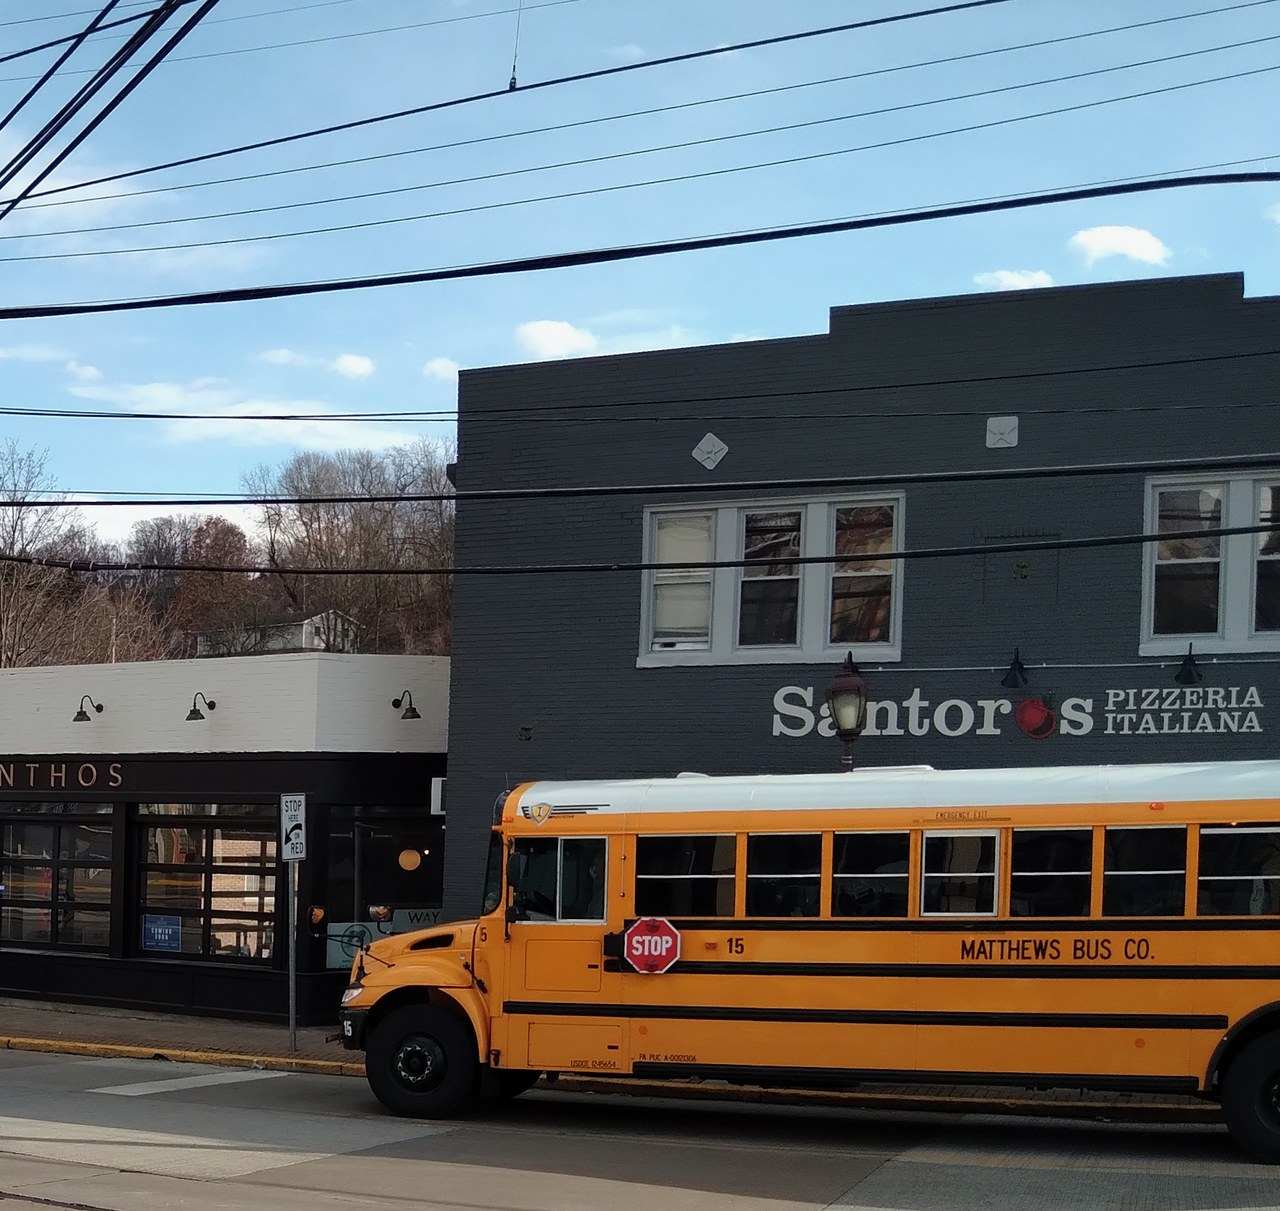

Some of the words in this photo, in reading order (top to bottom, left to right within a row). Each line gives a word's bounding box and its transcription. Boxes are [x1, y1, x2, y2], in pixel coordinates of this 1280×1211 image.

[1103, 686, 1265, 711] PIZZERIA
[1103, 711, 1264, 735] ITALIANA
[285, 800, 302, 812] STOP
[935, 811, 970, 820] EMERGENCY
[290, 842, 304, 855] RED
[408, 911, 440, 924] WAY
[631, 935, 673, 956] STOP
[726, 937, 745, 955] 15
[960, 939, 1061, 960] MATTHEWS
[1072, 938, 1112, 960] BUS
[1123, 938, 1155, 960] CO.
[343, 1020, 353, 1037] 15
